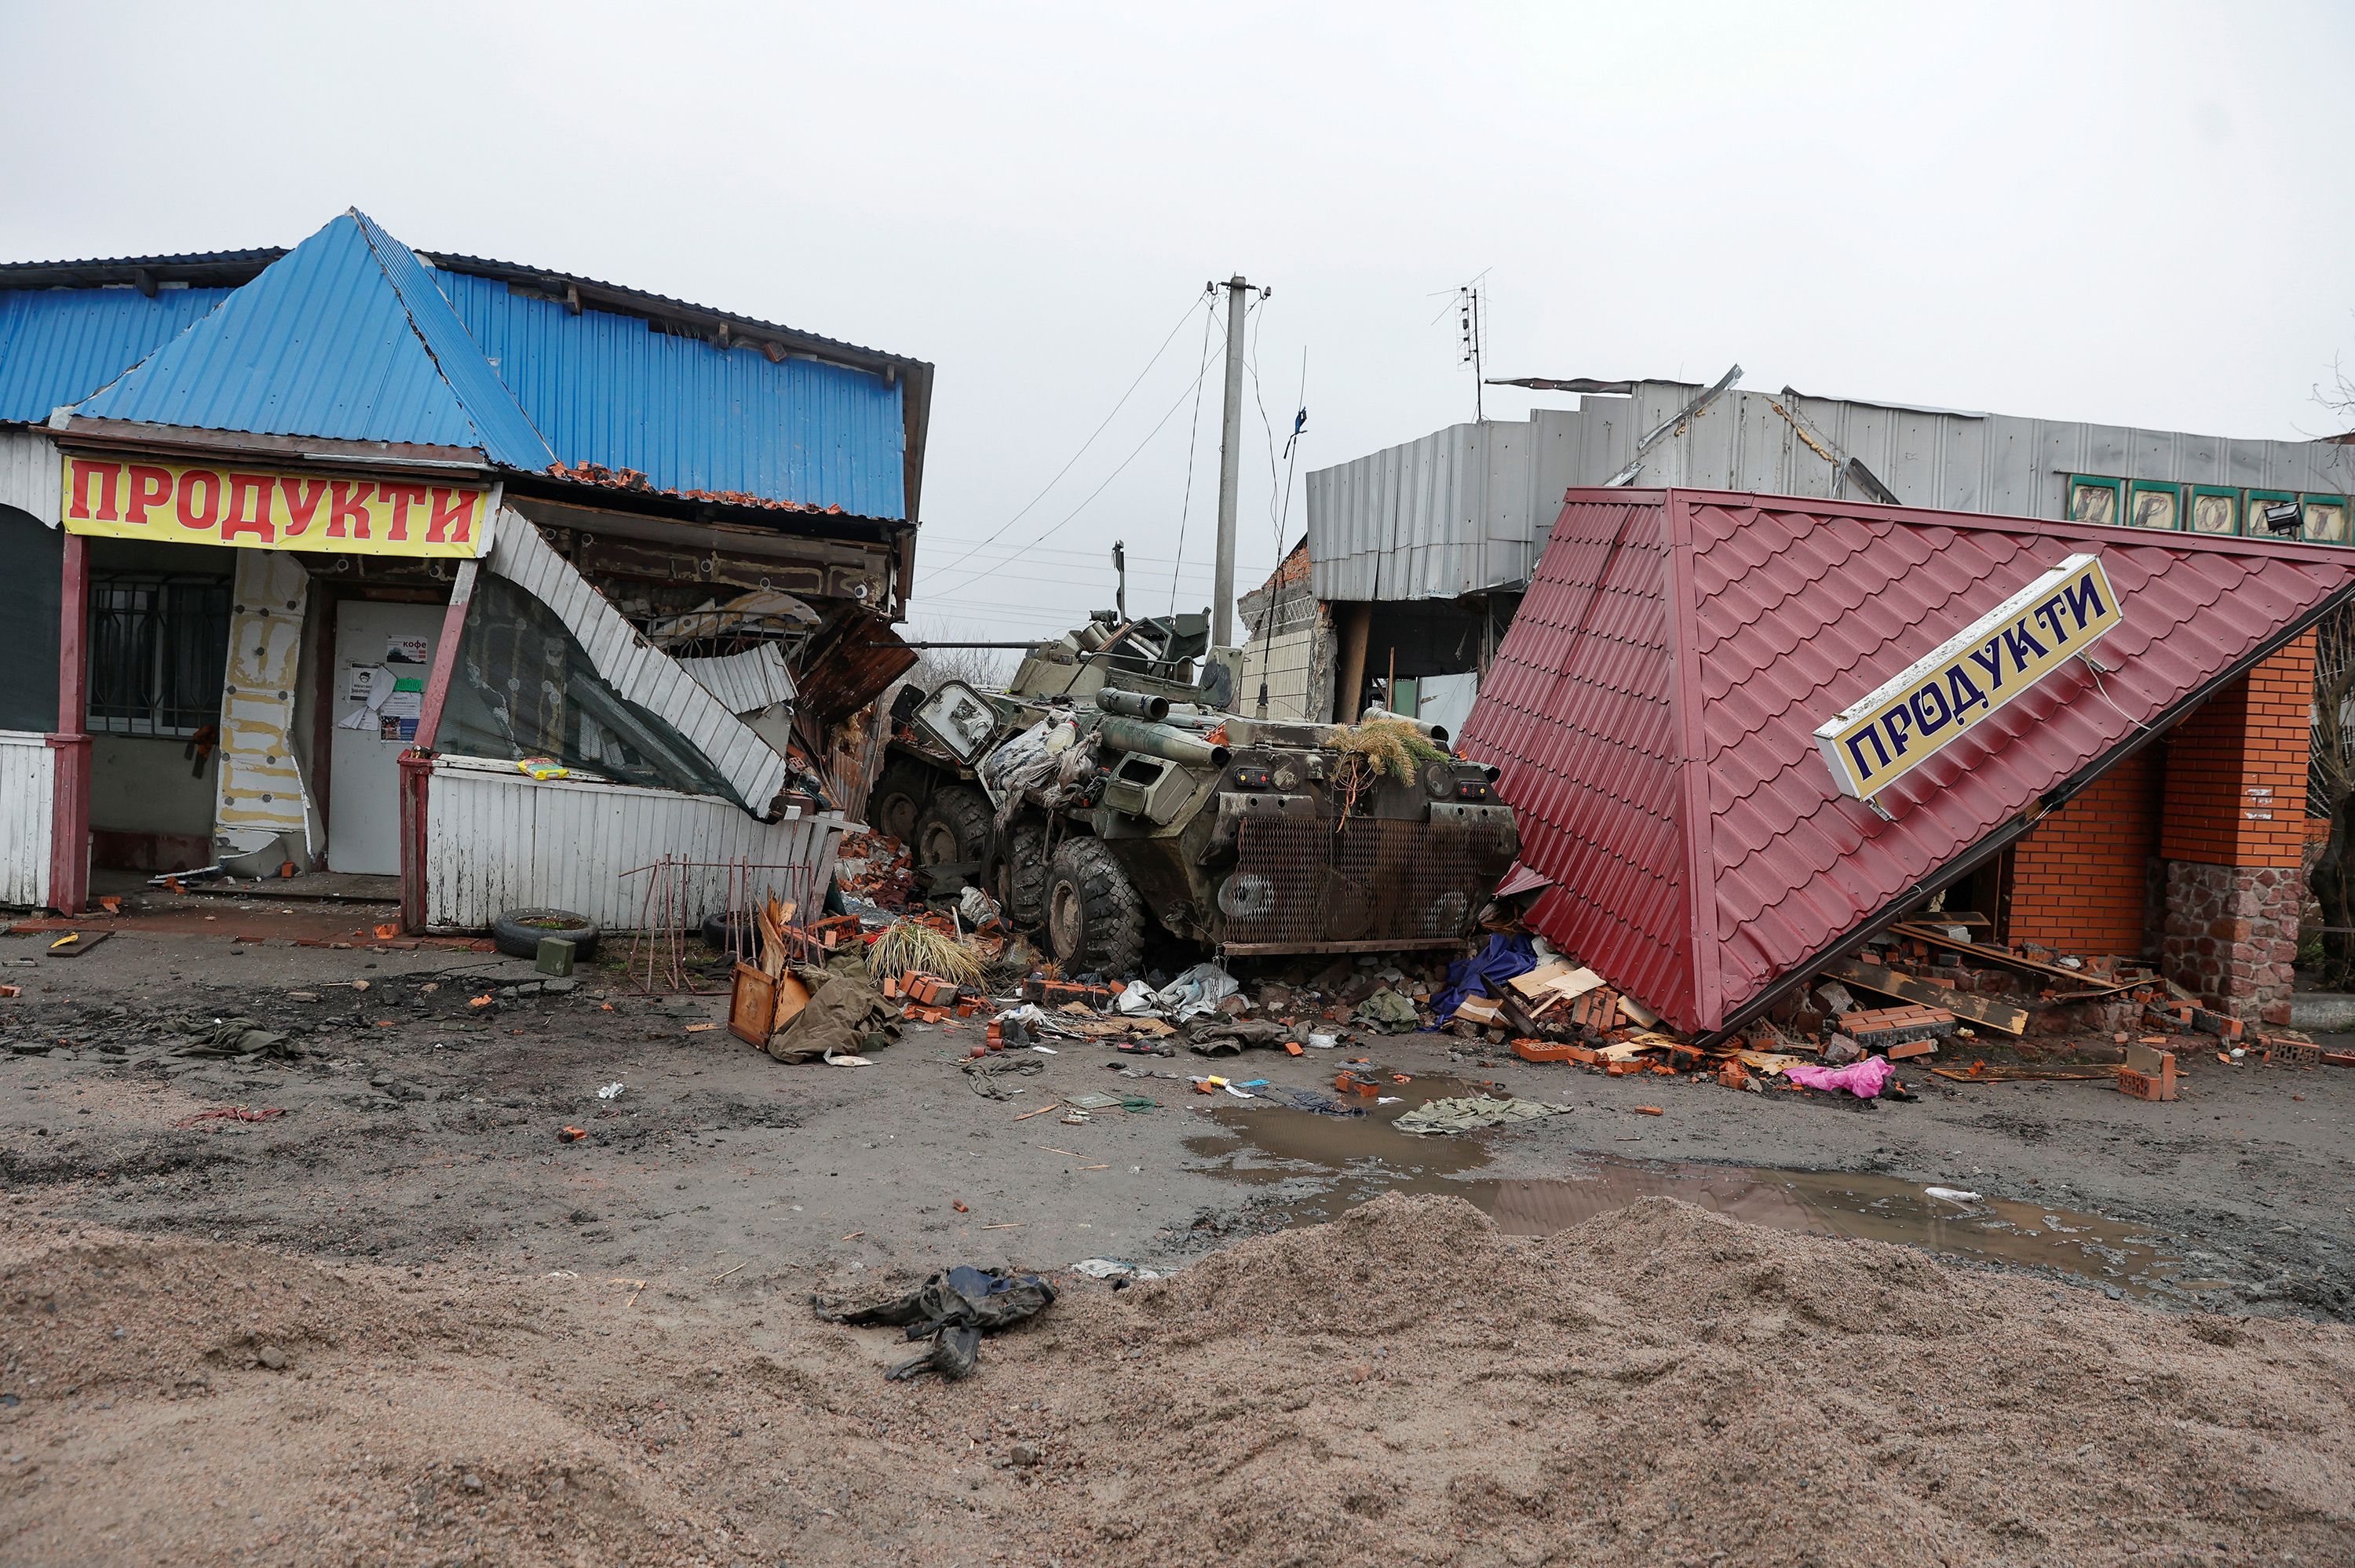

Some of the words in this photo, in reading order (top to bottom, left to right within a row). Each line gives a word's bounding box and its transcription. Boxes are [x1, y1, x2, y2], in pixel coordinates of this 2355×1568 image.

[68, 459, 480, 544] ПРОДУКТИ
[403, 640, 427, 649] кофе
[1844, 571, 2109, 782] ПРОДУКТИ
